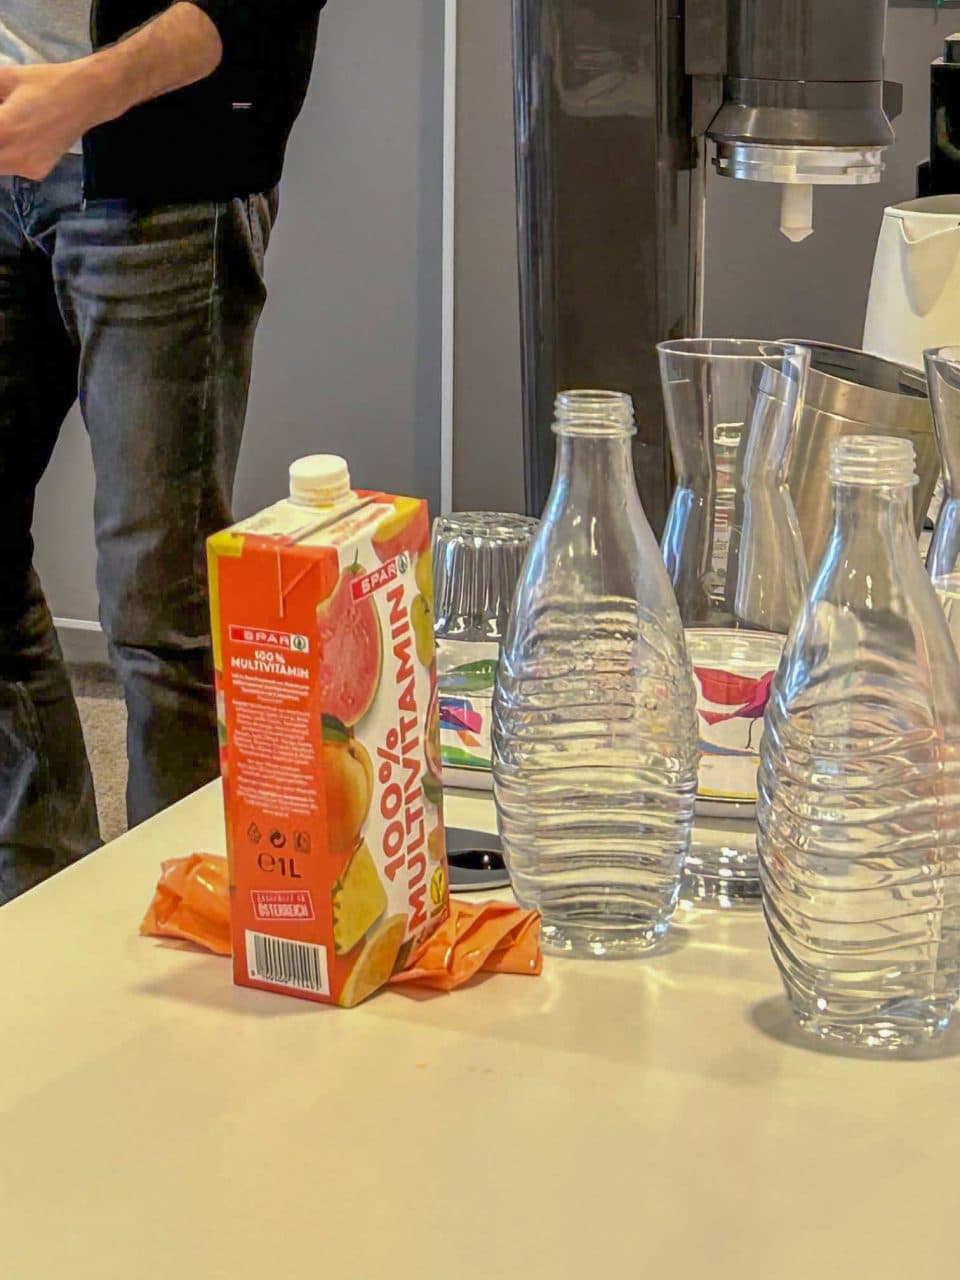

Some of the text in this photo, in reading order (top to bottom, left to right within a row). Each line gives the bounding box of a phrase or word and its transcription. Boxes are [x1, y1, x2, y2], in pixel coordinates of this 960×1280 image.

[361, 562, 398, 595] SPAR
[243, 629, 290, 646] SPAR
[230, 655, 310, 680] MULTIVITAMIN
[386, 583, 428, 933] MULTIVITAMIN
[376, 727, 405, 882] 100%
